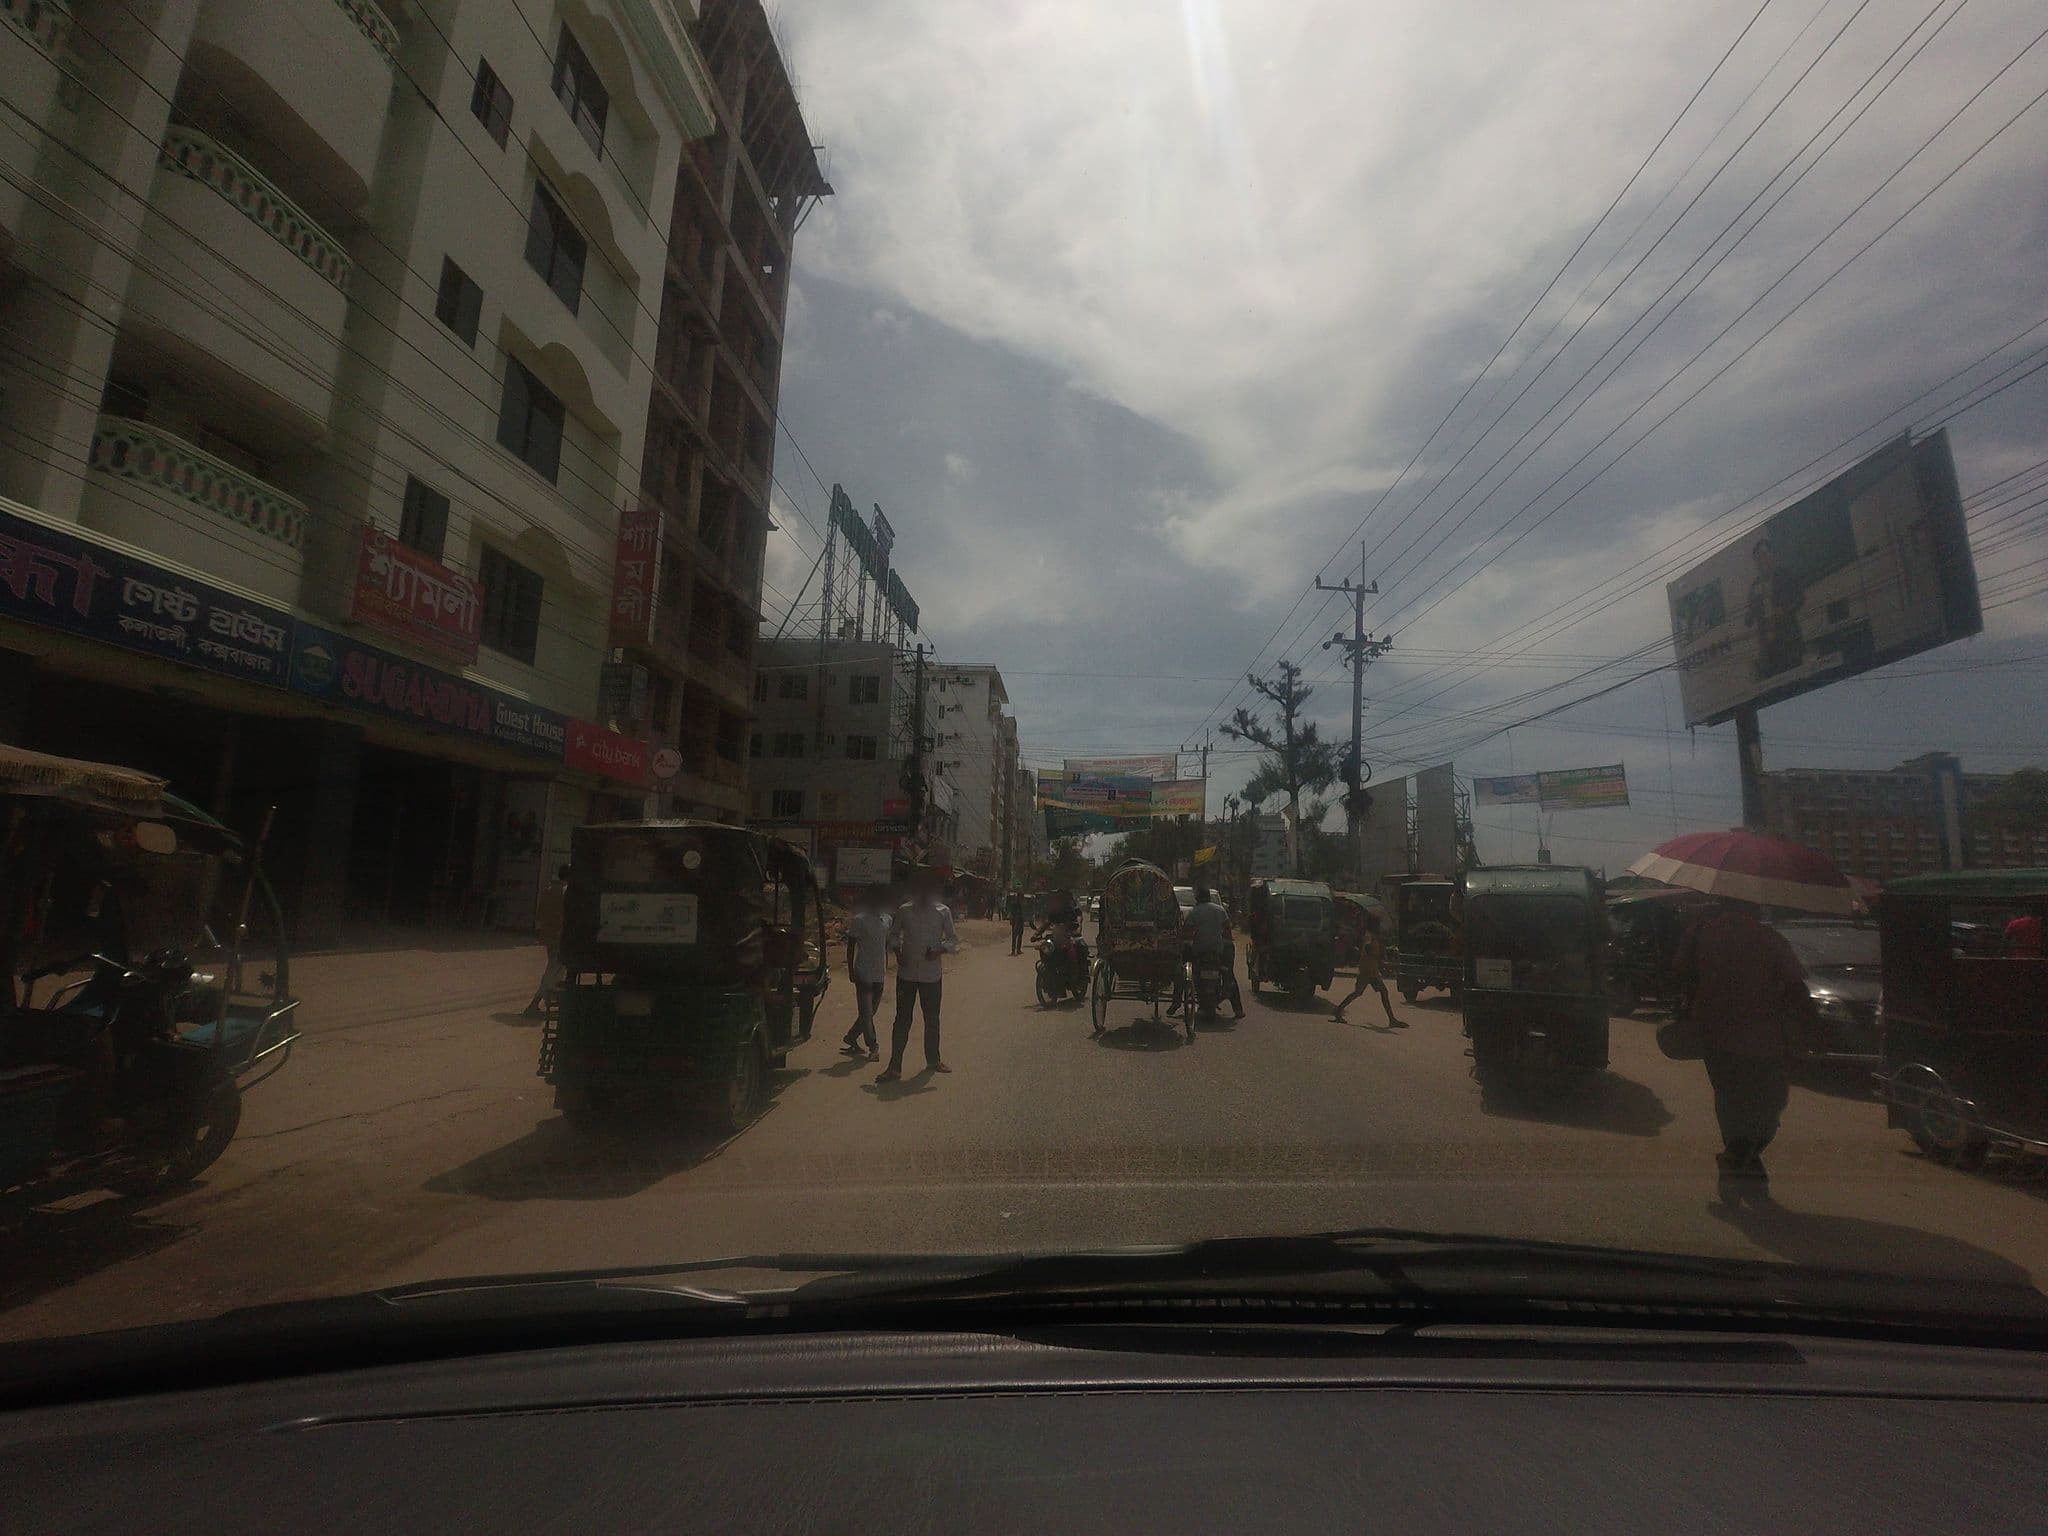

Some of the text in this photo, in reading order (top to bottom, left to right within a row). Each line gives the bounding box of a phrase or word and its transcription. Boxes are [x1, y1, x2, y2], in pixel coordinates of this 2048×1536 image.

[366, 545, 480, 633] শ্যামলী
[207, 606, 287, 652] হাউস
[496, 701, 531, 732] Guest
[532, 712, 565, 738] House
